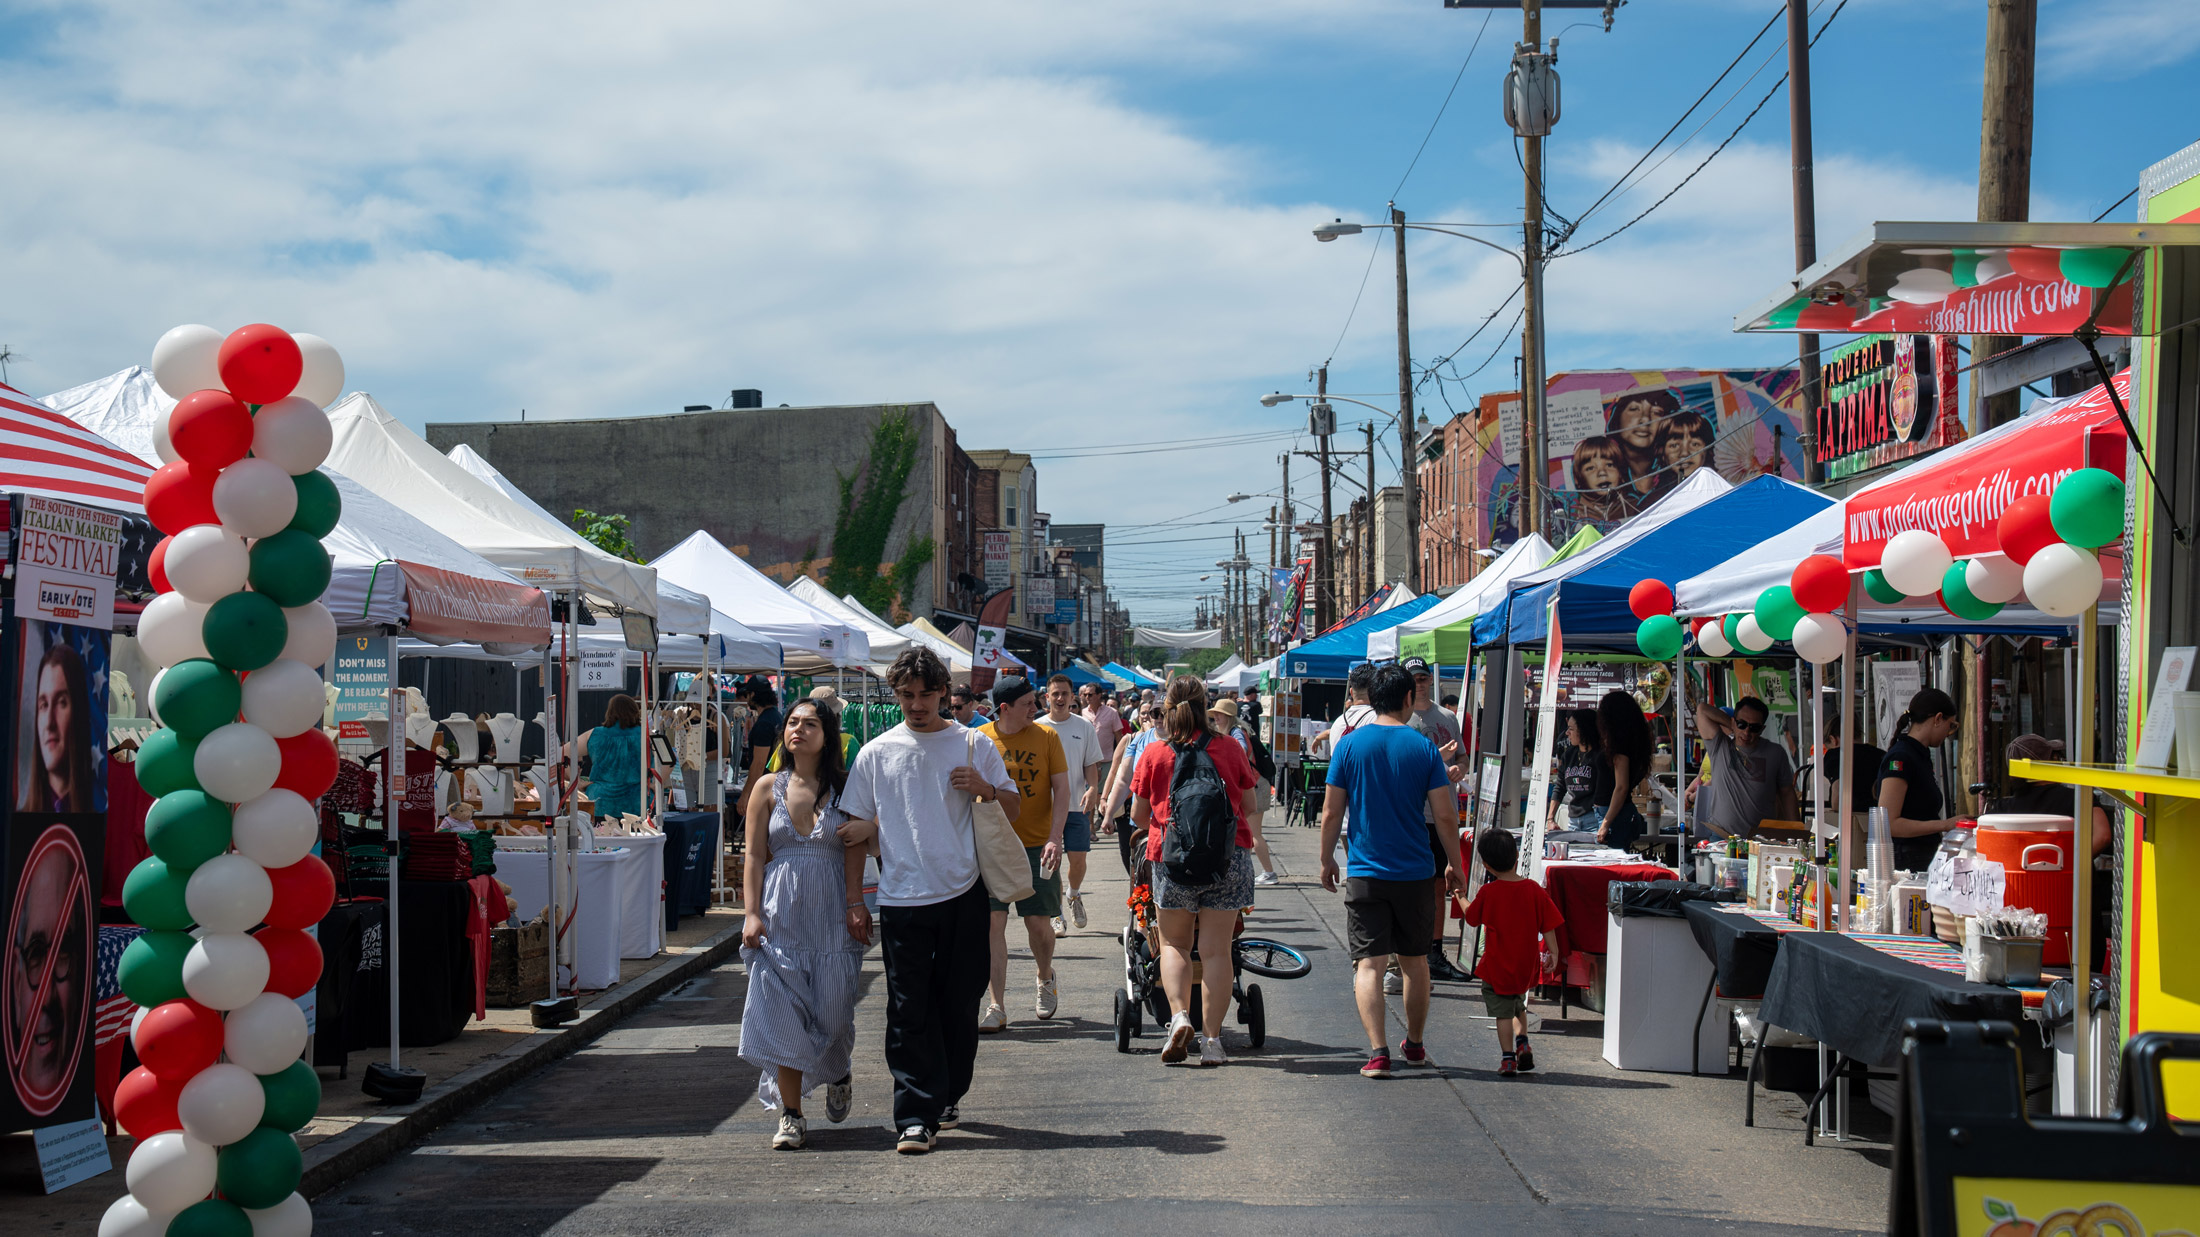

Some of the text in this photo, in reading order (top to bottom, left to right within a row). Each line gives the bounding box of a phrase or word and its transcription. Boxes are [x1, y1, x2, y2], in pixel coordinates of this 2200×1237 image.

[1823, 340, 1882, 388] TAQUERIA
[1817, 379, 1889, 463] LA PRIMA
[30, 498, 119, 527] THE SOUTH 9TH STREET
[23, 510, 121, 544] ITALIAN MARKET
[985, 535, 1009, 544] PUEBLO
[20, 528, 118, 577] FESTIVAL
[988, 544, 1005, 552] MEAT
[41, 591, 70, 605] EARLY
[54, 608, 78, 617] ACTION
[580, 651, 616, 659] Handmade
[339, 659, 386, 668] DON'T MISS
[336, 673, 389, 682] THE MOMENT.
[345, 688, 382, 696] BE READY
[336, 702, 388, 711] WITH REAL ID
[1003, 749, 1036, 766] AVE
